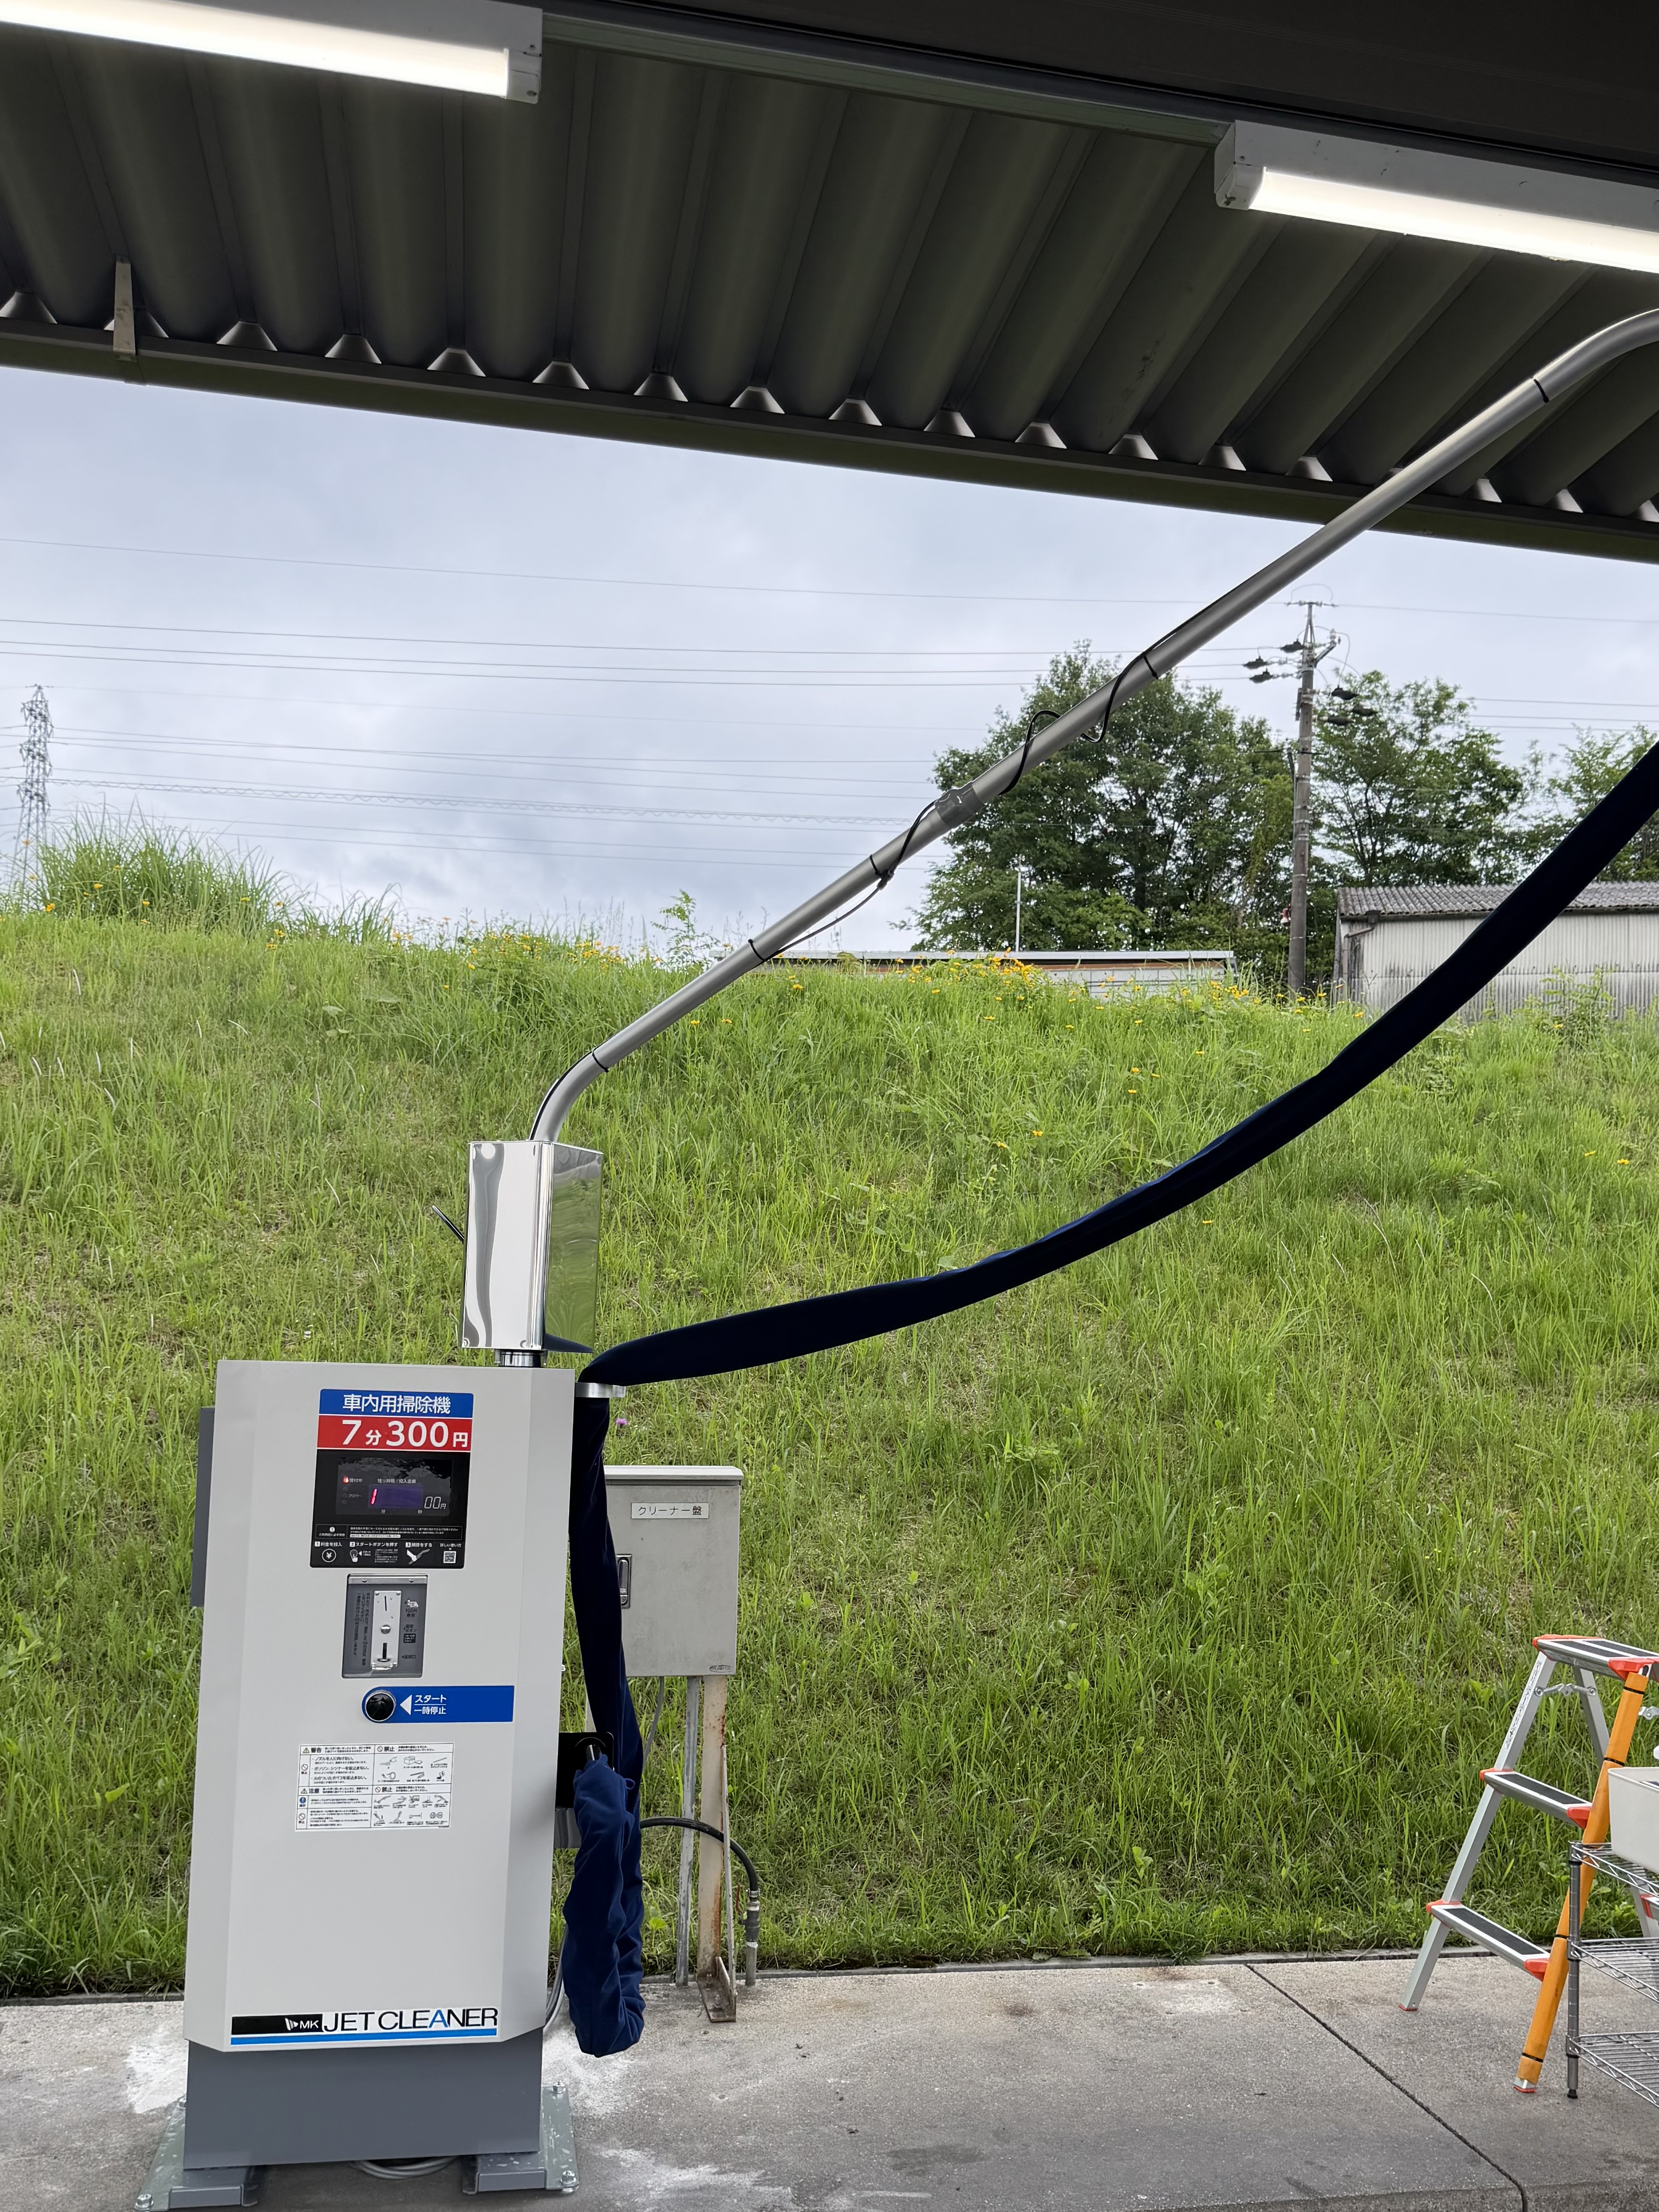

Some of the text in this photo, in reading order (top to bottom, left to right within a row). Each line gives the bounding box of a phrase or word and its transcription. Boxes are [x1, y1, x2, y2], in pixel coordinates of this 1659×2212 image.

[342, 1393, 451, 1414] 車内用掃除機
[639, 1506, 702, 1515] クリーナー盤
[415, 1694, 447, 1703] スタート
[414, 1706, 446, 1715] 一時停止
[300, 2008, 498, 2032] MK JET CLEANER
